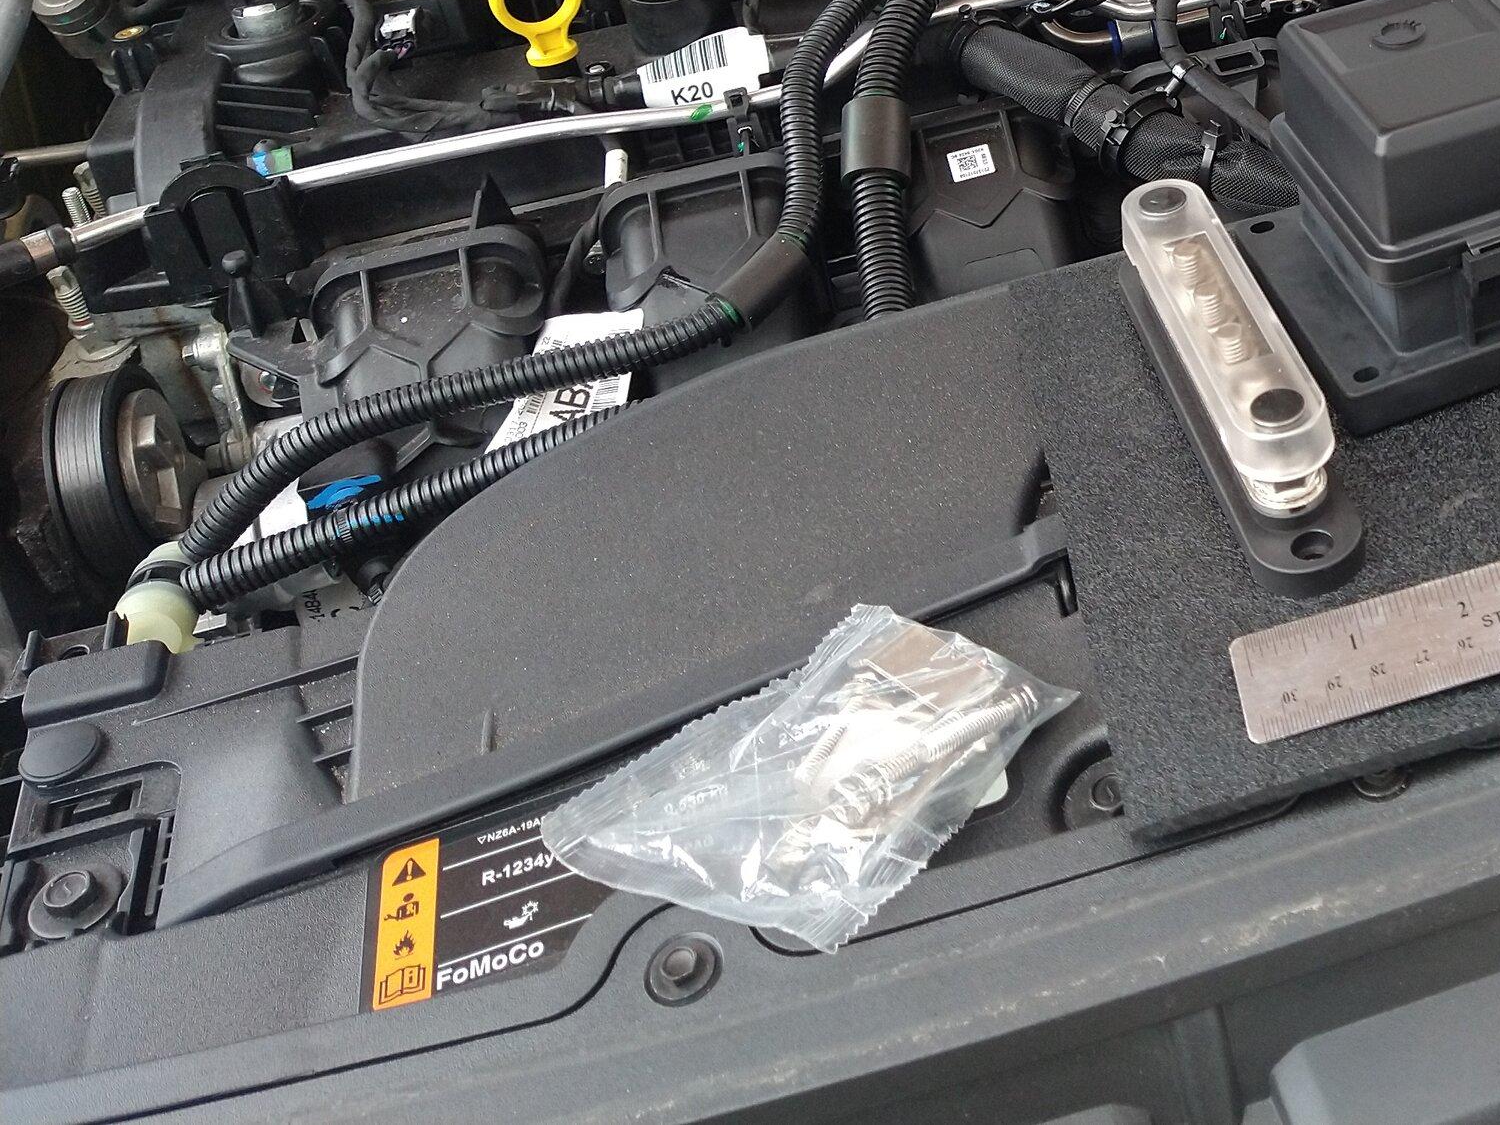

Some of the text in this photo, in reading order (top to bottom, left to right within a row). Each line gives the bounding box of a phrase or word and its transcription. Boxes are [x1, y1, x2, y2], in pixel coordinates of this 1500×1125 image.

[670, 81, 714, 106] K20
[1349, 633, 1358, 651] 1
[1457, 601, 1469, 619] 2
[1457, 636, 1475, 651] 26
[1414, 649, 1431, 665] 27
[1370, 662, 1388, 678] 28
[1327, 675, 1344, 691] 29
[1281, 688, 1298, 705] 30
[481, 852, 558, 887] R-1234y
[436, 941, 545, 991] FoMoCo
